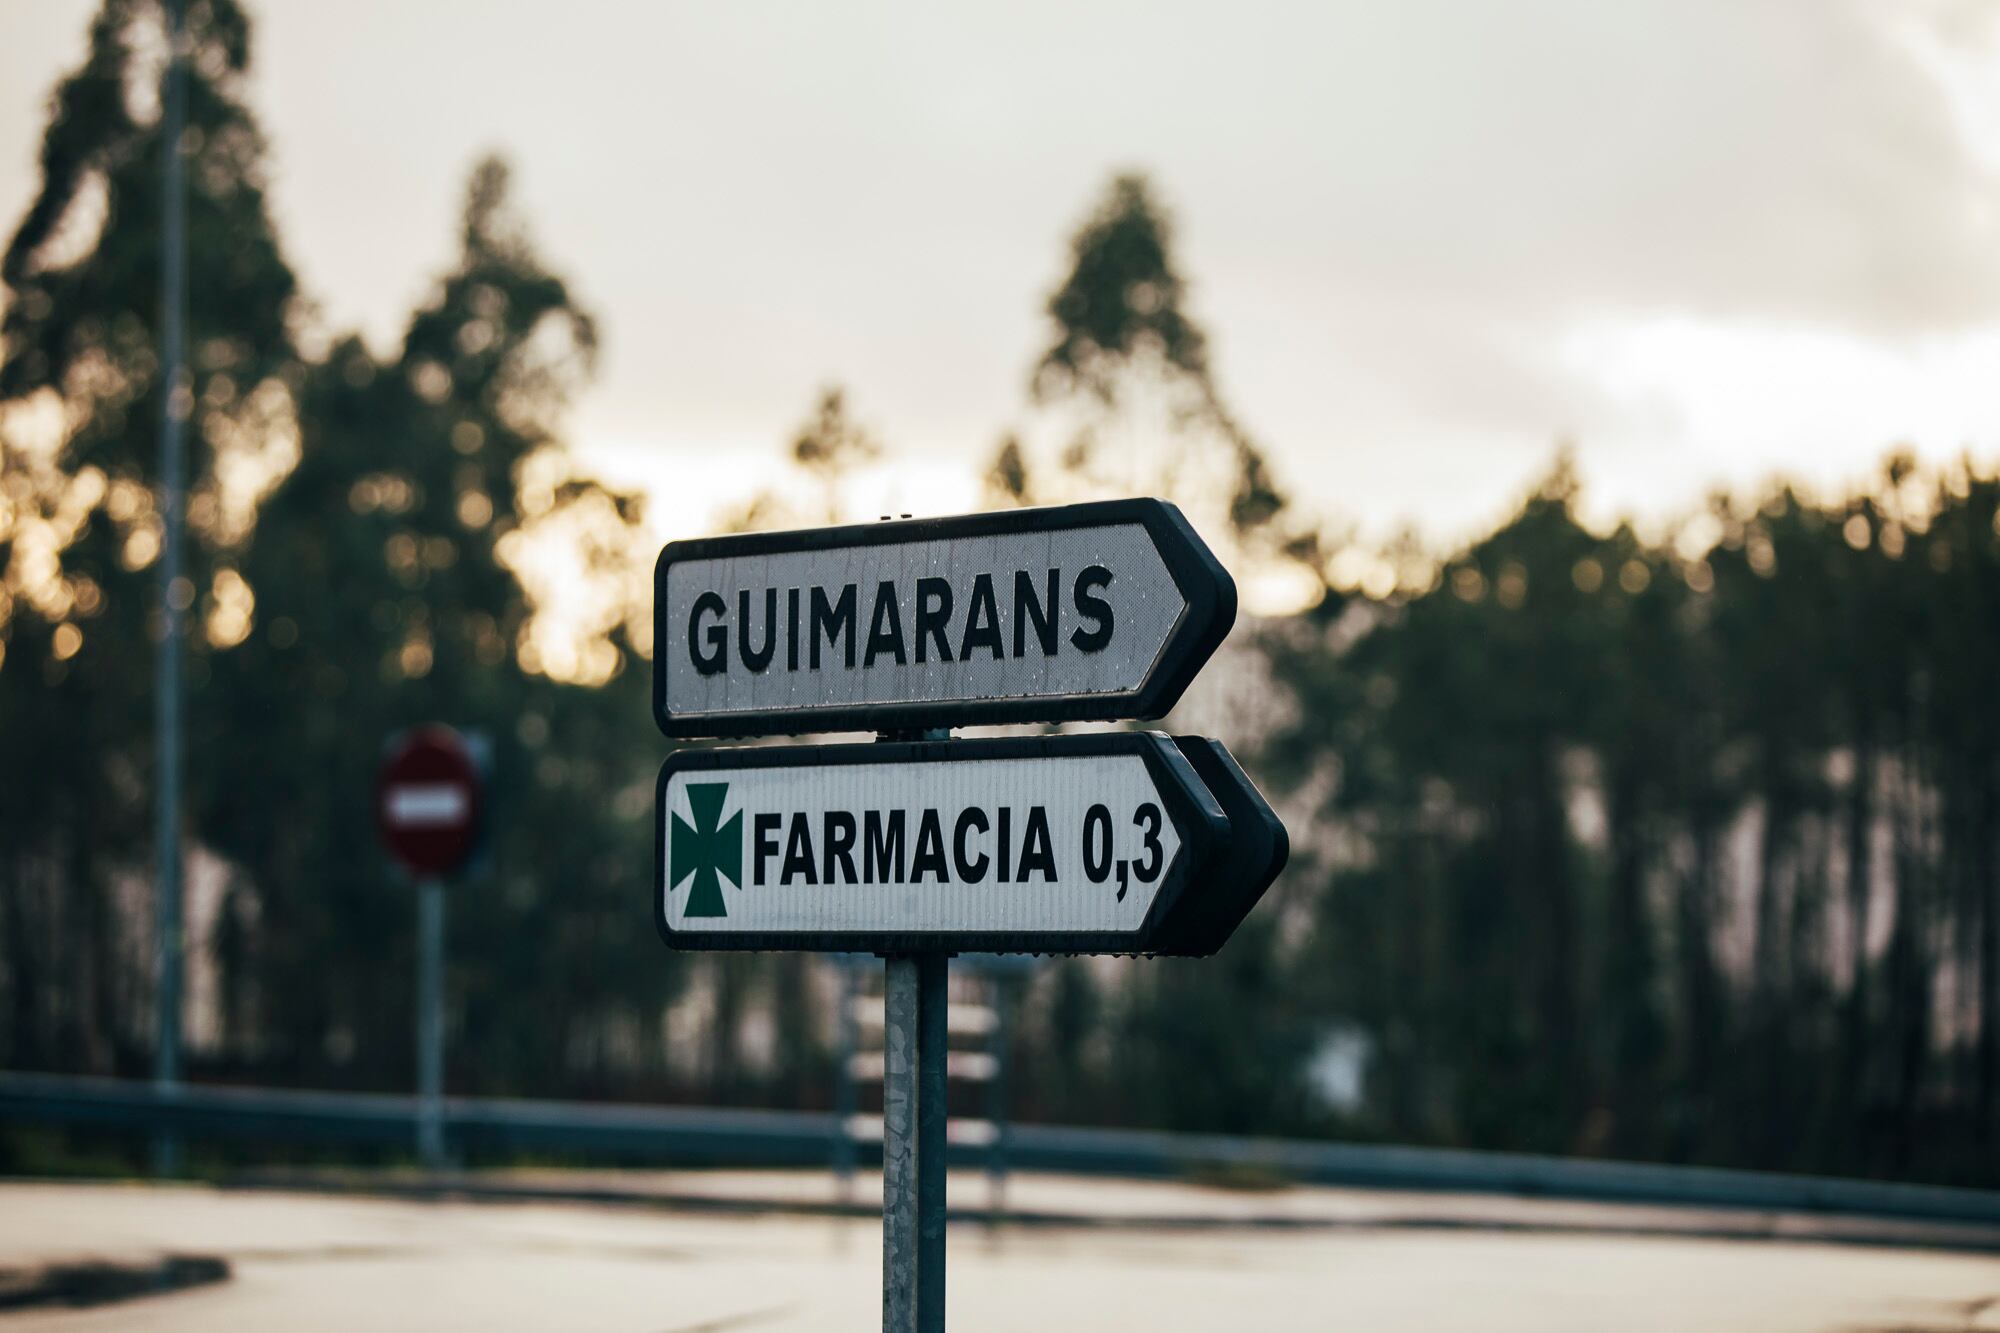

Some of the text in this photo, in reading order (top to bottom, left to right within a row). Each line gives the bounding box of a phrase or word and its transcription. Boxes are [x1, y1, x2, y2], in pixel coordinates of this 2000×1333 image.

[688, 565, 1115, 675] GUIMARANS
[753, 802, 1164, 903] FARMACIA 0,3
